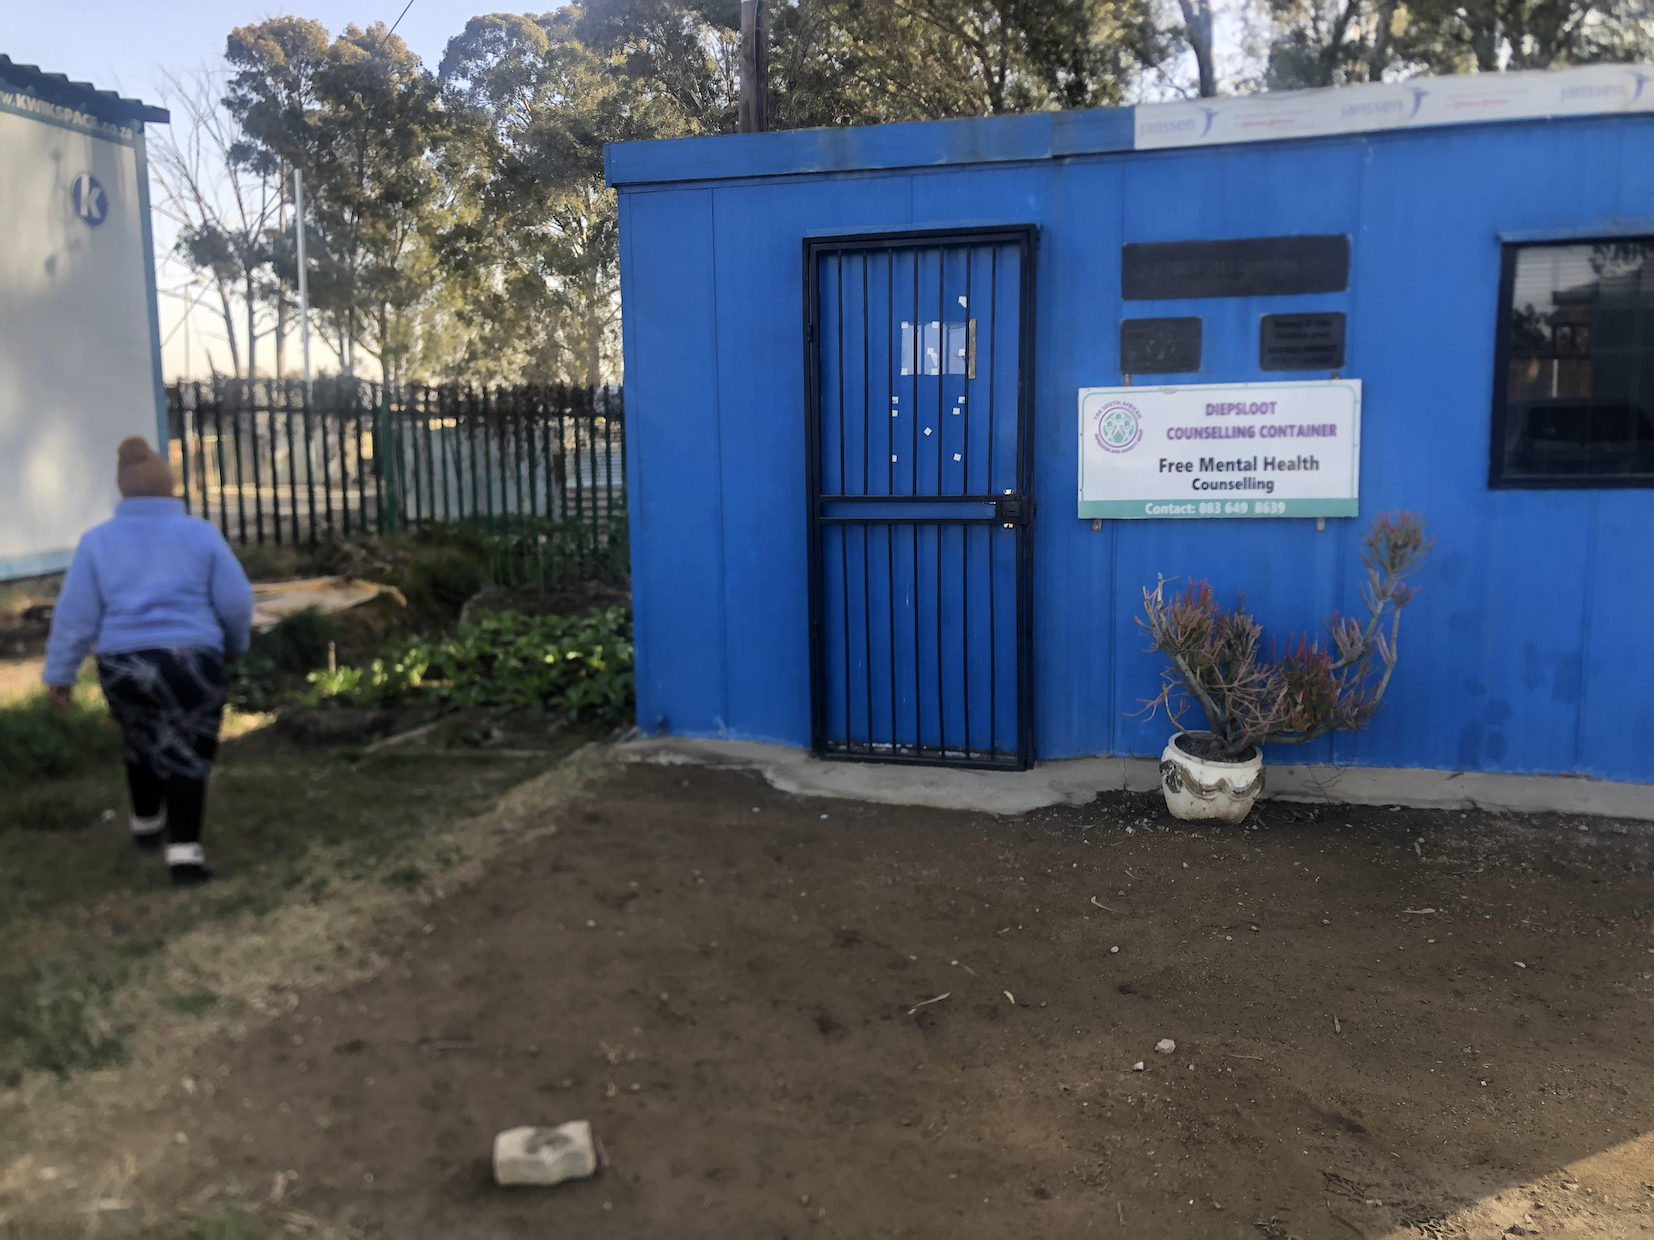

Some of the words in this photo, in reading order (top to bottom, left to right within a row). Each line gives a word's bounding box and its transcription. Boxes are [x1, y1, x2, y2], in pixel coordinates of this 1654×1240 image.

[1205, 401, 1277, 416] DIEPSLOOT
[1166, 426, 1256, 440] COUNSELLING
[1259, 423, 1337, 438] CONTAINER
[1159, 458, 1194, 473] Free
[1199, 456, 1257, 472] Mental
[1264, 455, 1320, 471] Health
[1192, 477, 1275, 494] Counselling
[1144, 503, 1196, 515] Contact:
[1198, 502, 1222, 514] 083
[1224, 502, 1249, 514] 649
[1254, 501, 1286, 514] 8639
